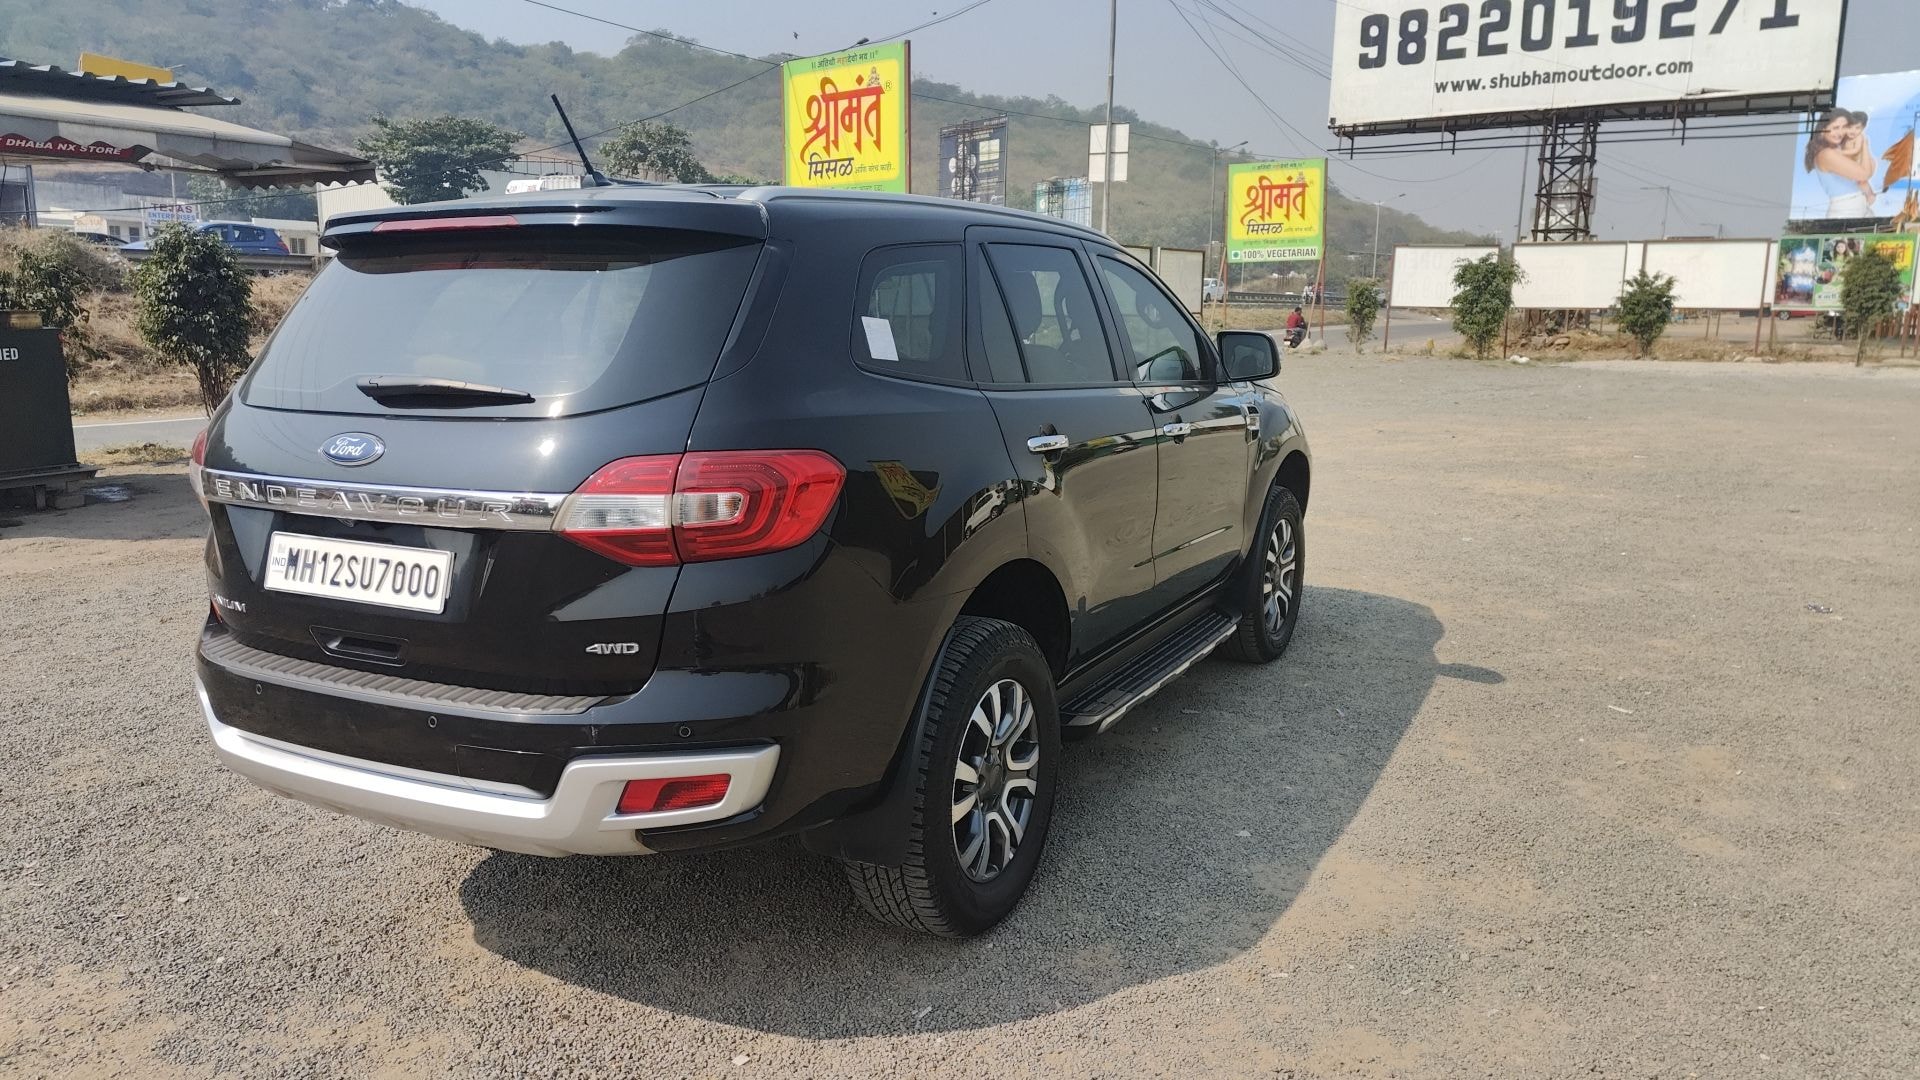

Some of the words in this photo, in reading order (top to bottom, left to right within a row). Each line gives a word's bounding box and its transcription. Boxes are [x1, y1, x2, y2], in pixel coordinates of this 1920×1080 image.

[1435, 62, 1693, 94] www.shubhamoutdoor.com
[800, 74, 885, 165] श्रीमंत
[6, 138, 53, 150] DHABA
[57, 143, 76, 151] NX
[79, 145, 121, 155] STORE
[808, 152, 854, 180] मिसळ
[1240, 175, 1309, 225] श्रीमंत
[1246, 219, 1284, 236] मिसळ
[1243, 250, 1264, 259] 100%
[1266, 247, 1316, 258] VEGETARIAN
[0, 347, 19, 361] ED
[330, 436, 367, 456] Ford
[215, 478, 514, 522] ENDEAVOUR
[284, 547, 440, 599] MH12SU7000
[585, 642, 640, 655] 4WD
